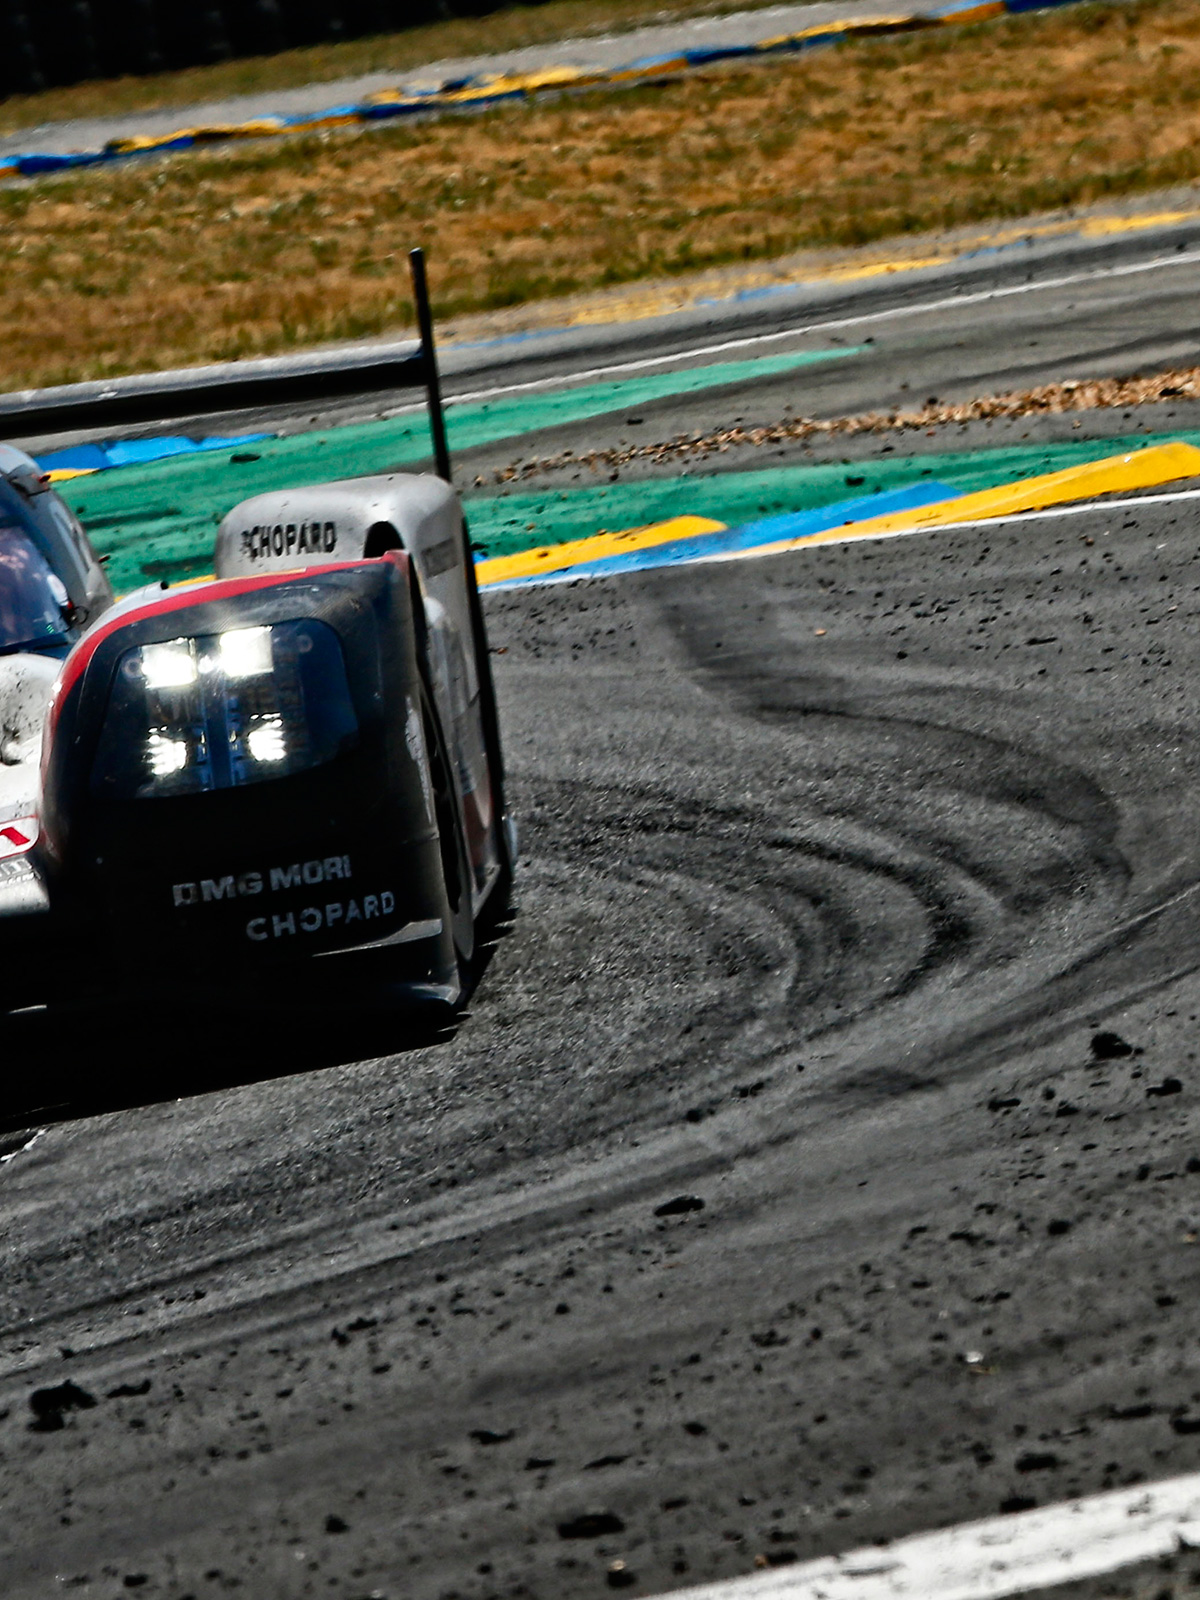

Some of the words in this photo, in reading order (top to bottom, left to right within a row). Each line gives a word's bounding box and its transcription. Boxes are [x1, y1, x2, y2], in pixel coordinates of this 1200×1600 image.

[247, 521, 337, 560] CHOPARD
[172, 871, 263, 906] DMG
[270, 854, 353, 890] MORI
[246, 891, 396, 941] CHOPARD
